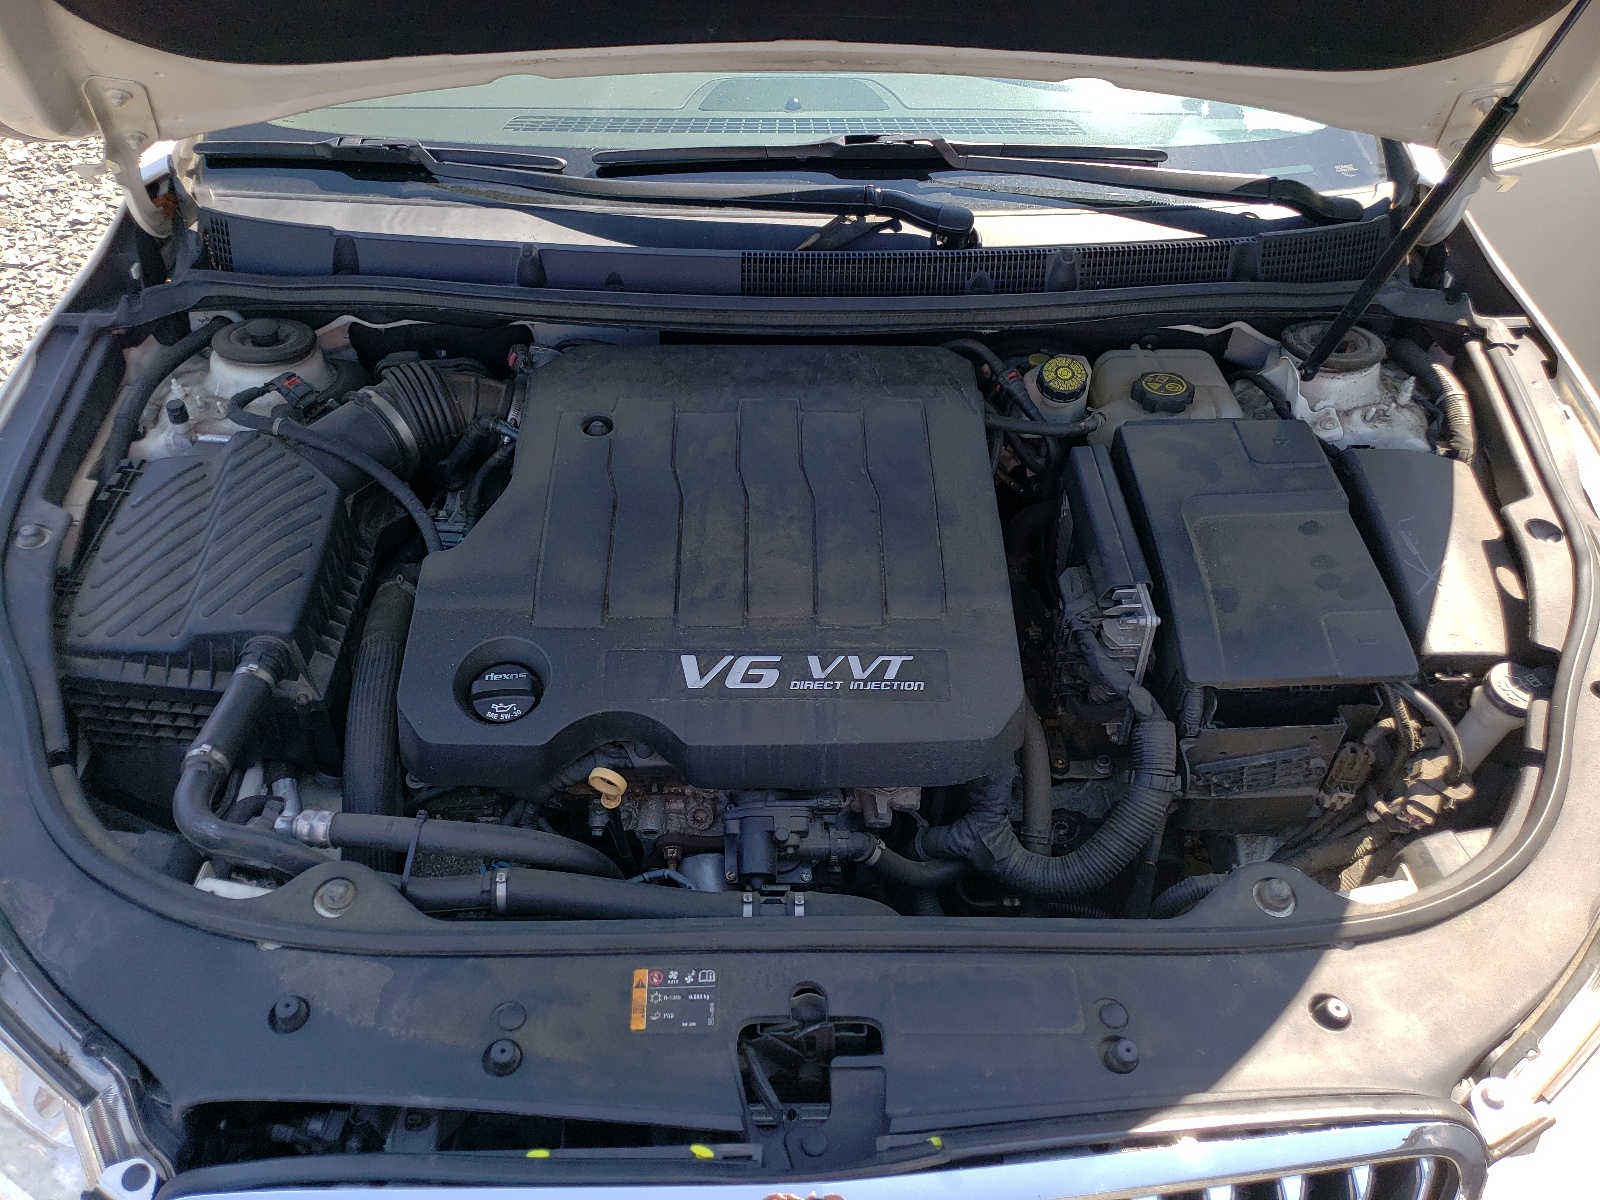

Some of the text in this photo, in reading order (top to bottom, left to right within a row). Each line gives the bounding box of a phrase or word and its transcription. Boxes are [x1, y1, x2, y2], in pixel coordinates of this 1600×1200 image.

[680, 654, 914, 689] V6 VVT
[789, 681, 925, 691] DIRECT INJECTION
[485, 709, 522, 720] SAE 5W-30
